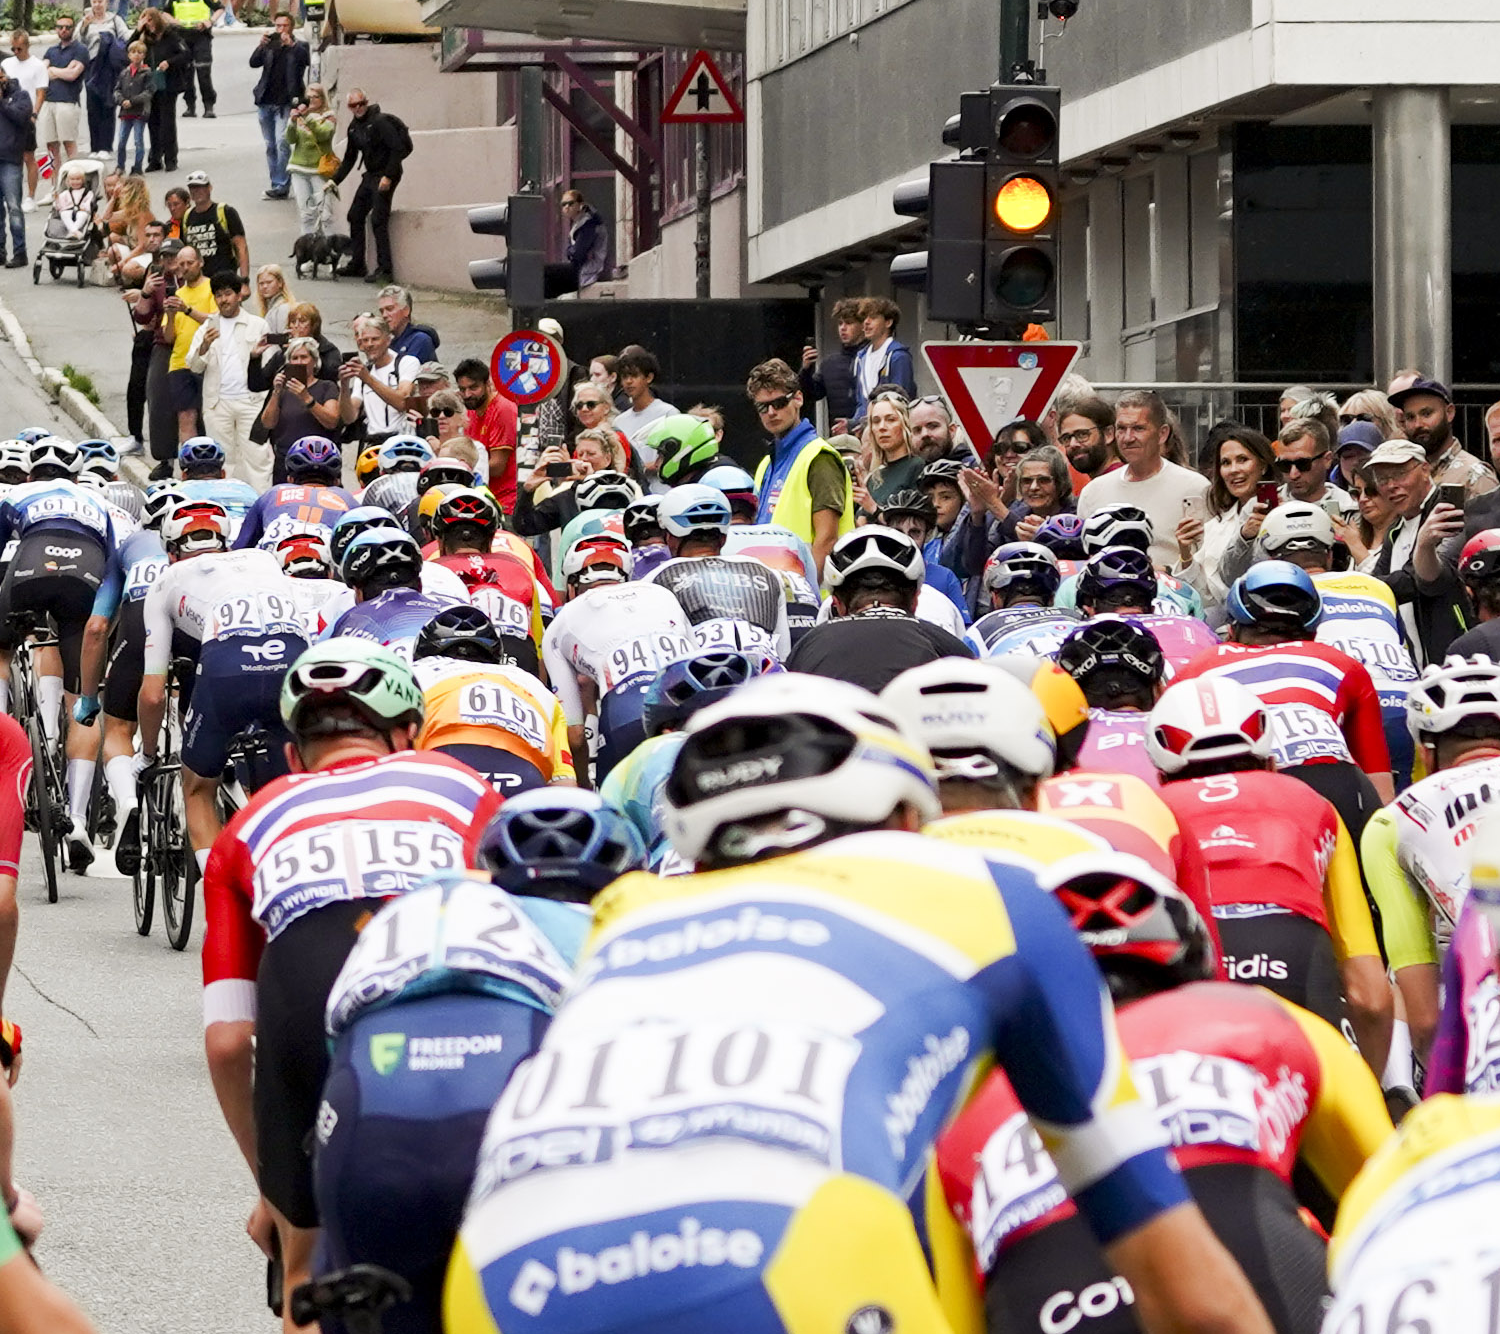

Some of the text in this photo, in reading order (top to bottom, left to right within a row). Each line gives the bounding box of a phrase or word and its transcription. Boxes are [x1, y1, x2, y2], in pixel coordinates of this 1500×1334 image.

[44, 545, 82, 558] coop
[711, 574, 769, 592] UBS
[220, 599, 253, 627] 92
[496, 597, 524, 625] 16
[1323, 602, 1383, 616] baloise
[612, 640, 648, 676] 94
[468, 684, 506, 715] 61
[362, 829, 455, 871] 155
[283, 883, 345, 911] HYUNDAI
[408, 1035, 502, 1057] FREEDOM
[652, 1028, 824, 1105] 101
[1149, 1061, 1228, 1109] 14
[554, 1219, 764, 1296] baloise
